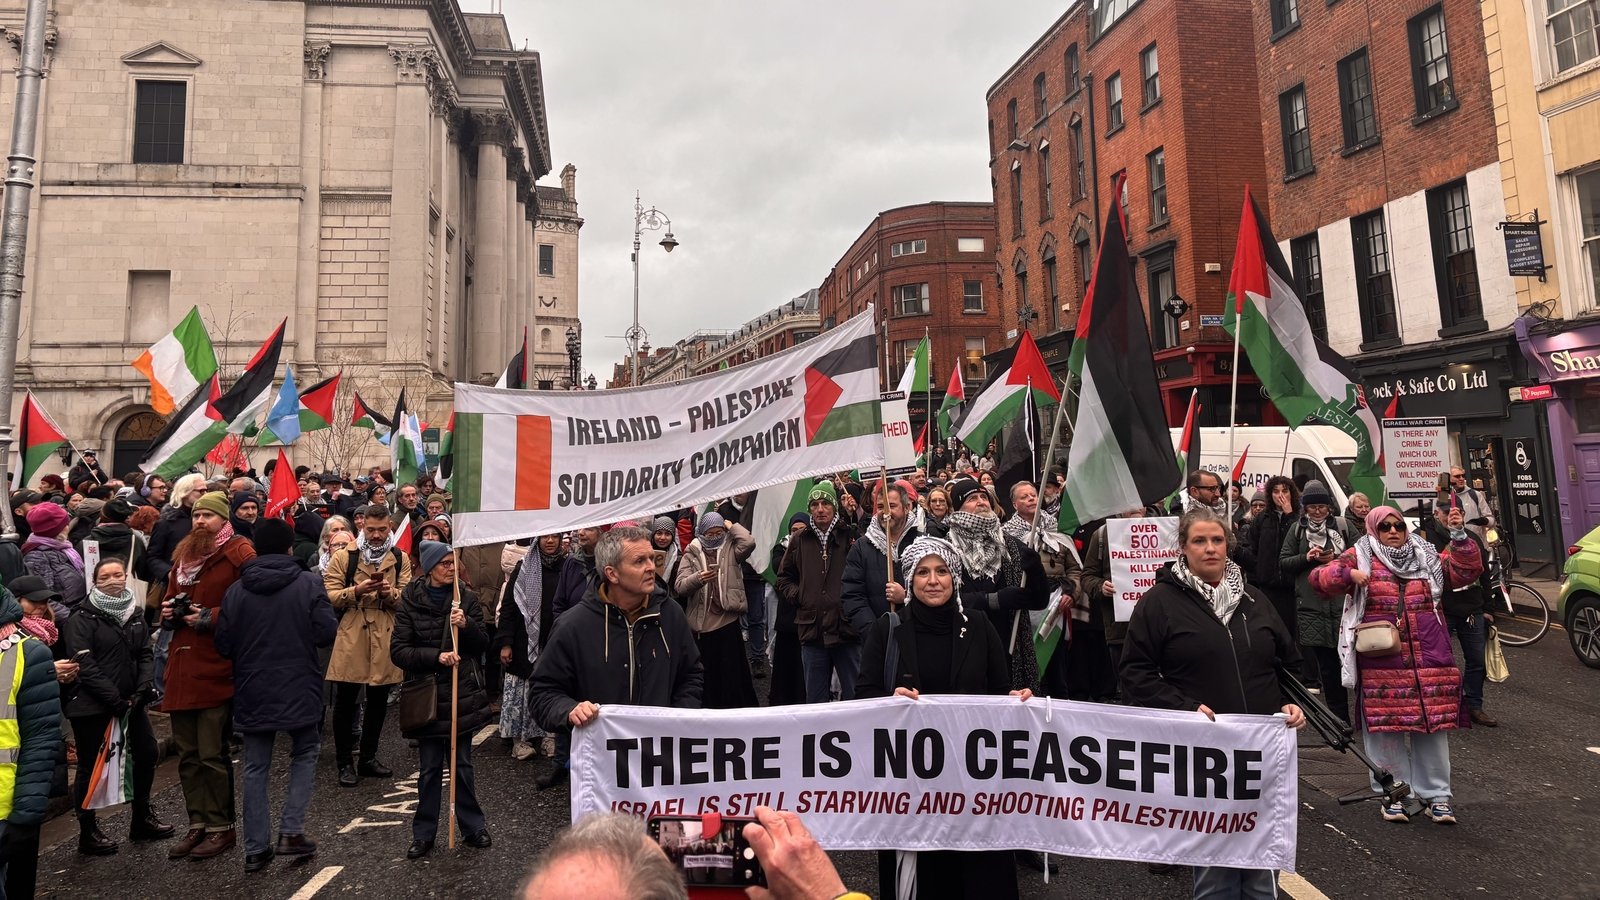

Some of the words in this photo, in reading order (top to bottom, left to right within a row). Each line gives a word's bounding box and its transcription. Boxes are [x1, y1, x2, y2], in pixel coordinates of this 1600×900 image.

[1373, 382, 1392, 398] ock
[1396, 380, 1407, 396] &
[1409, 376, 1434, 395] Safe
[1436, 374, 1456, 392] Co
[1462, 370, 1488, 390] Ltd
[568, 414, 662, 446] IRELAND
[688, 375, 795, 433] PALESTINE
[882, 421, 908, 438] THEID
[558, 458, 682, 507] SOLIDARITY
[690, 417, 800, 478] CAMPAIGN
[1218, 464, 1229, 472] Poib
[1240, 472, 1275, 488] GARD
[1131, 525, 1158, 533] OVER
[1131, 535, 1158, 549] 500
[1112, 549, 1181, 559] PALESTINIANS
[1134, 579, 1157, 587] SINC
[1122, 592, 1145, 600] CEA
[606, 736, 781, 788] THERE
[802, 730, 851, 779] IS
[874, 728, 945, 780] NO
[965, 728, 1262, 800] CEASEFIRE
[698, 796, 720, 815] IS
[726, 792, 788, 815] STILL
[796, 790, 910, 815] STARVING
[916, 790, 966, 814] AND
[972, 791, 1084, 820] SHOOTING
[1092, 798, 1258, 834] PALESTINIANS
